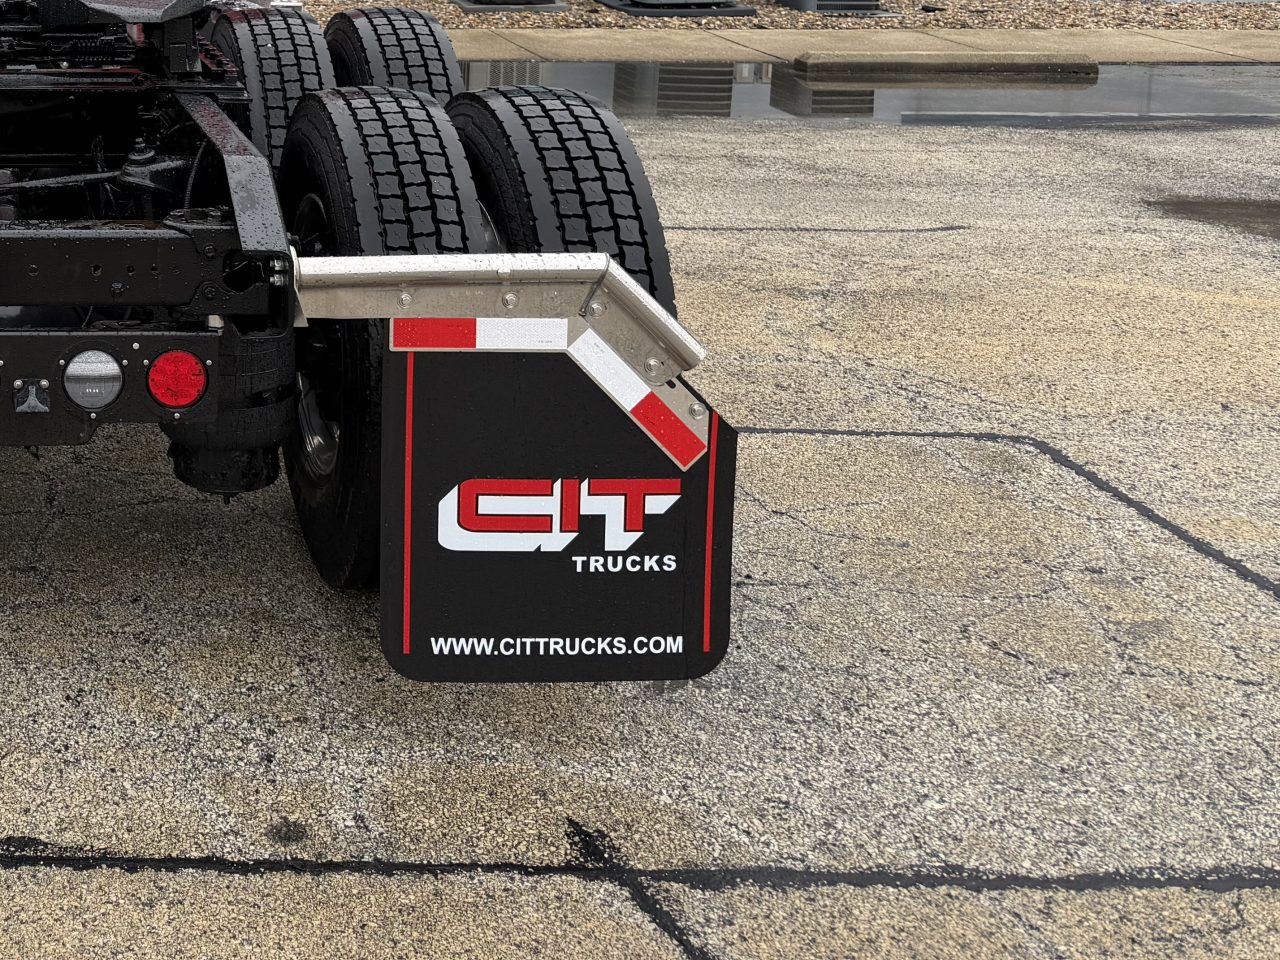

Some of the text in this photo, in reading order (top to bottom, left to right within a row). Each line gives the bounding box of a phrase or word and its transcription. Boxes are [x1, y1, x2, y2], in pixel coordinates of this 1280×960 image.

[437, 477, 682, 552] CIT
[571, 554, 677, 573] TRUCKS
[430, 635, 684, 656] WWW.CITTRUCKS.COM
